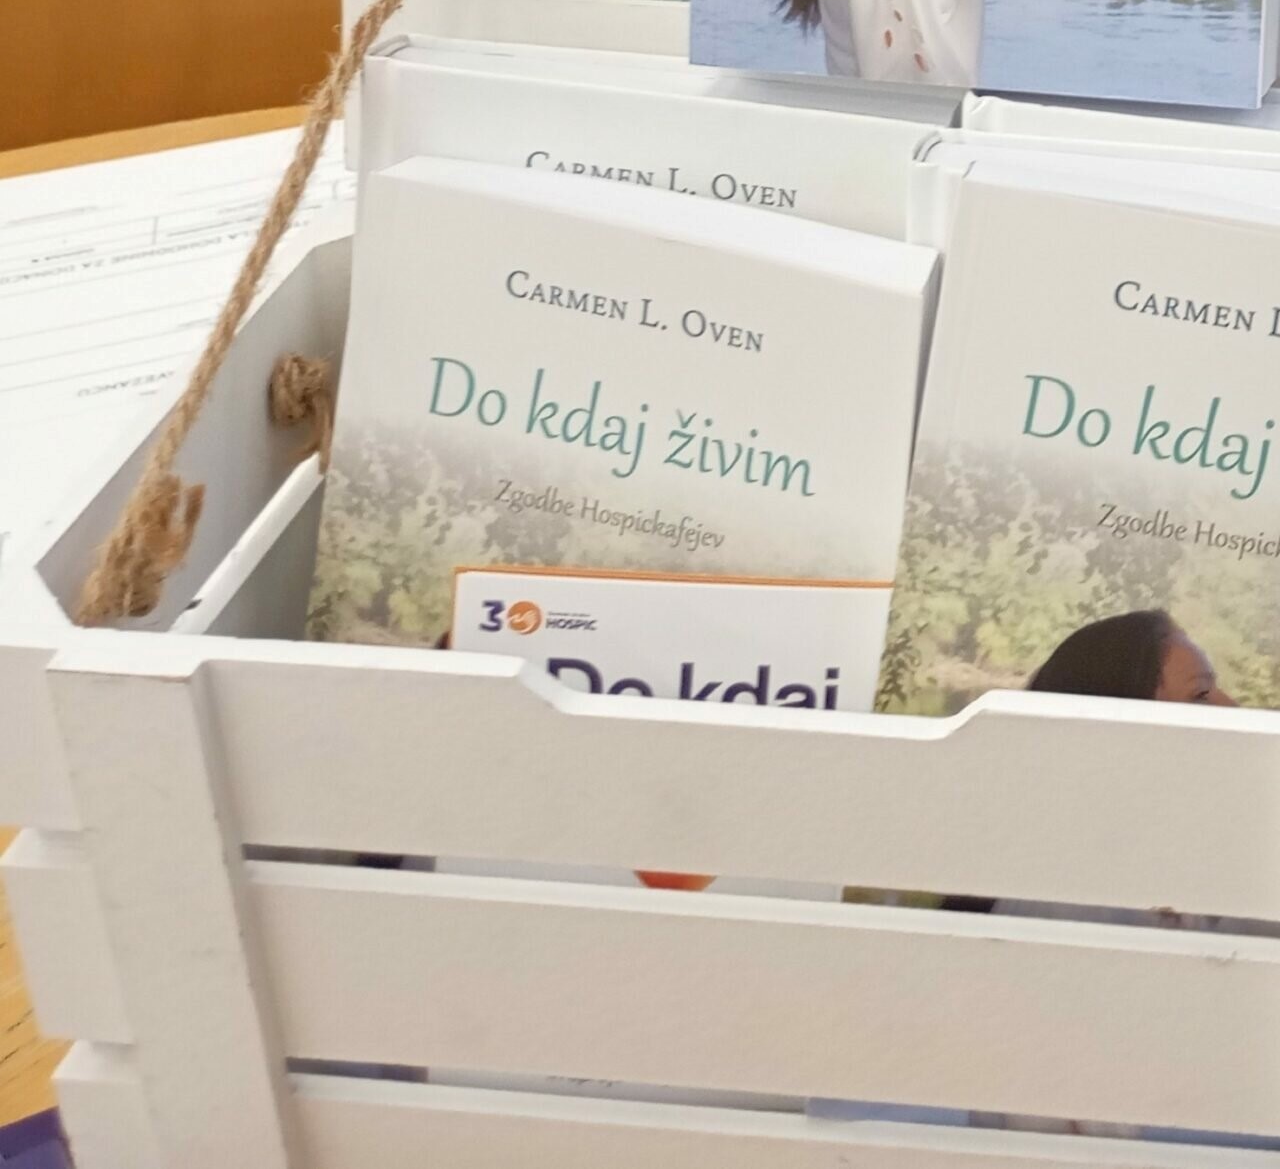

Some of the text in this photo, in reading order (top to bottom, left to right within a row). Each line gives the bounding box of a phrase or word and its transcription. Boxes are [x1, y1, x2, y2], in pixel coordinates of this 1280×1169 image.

[638, 298, 668, 331] L.
[428, 356, 816, 498] Do kdaj živim
[1022, 374, 1112, 448] Do
[1131, 384, 1276, 501] kdaj
[493, 478, 726, 551] Zgodbe Hospickafejev
[1097, 503, 1188, 540] Zgodbe
